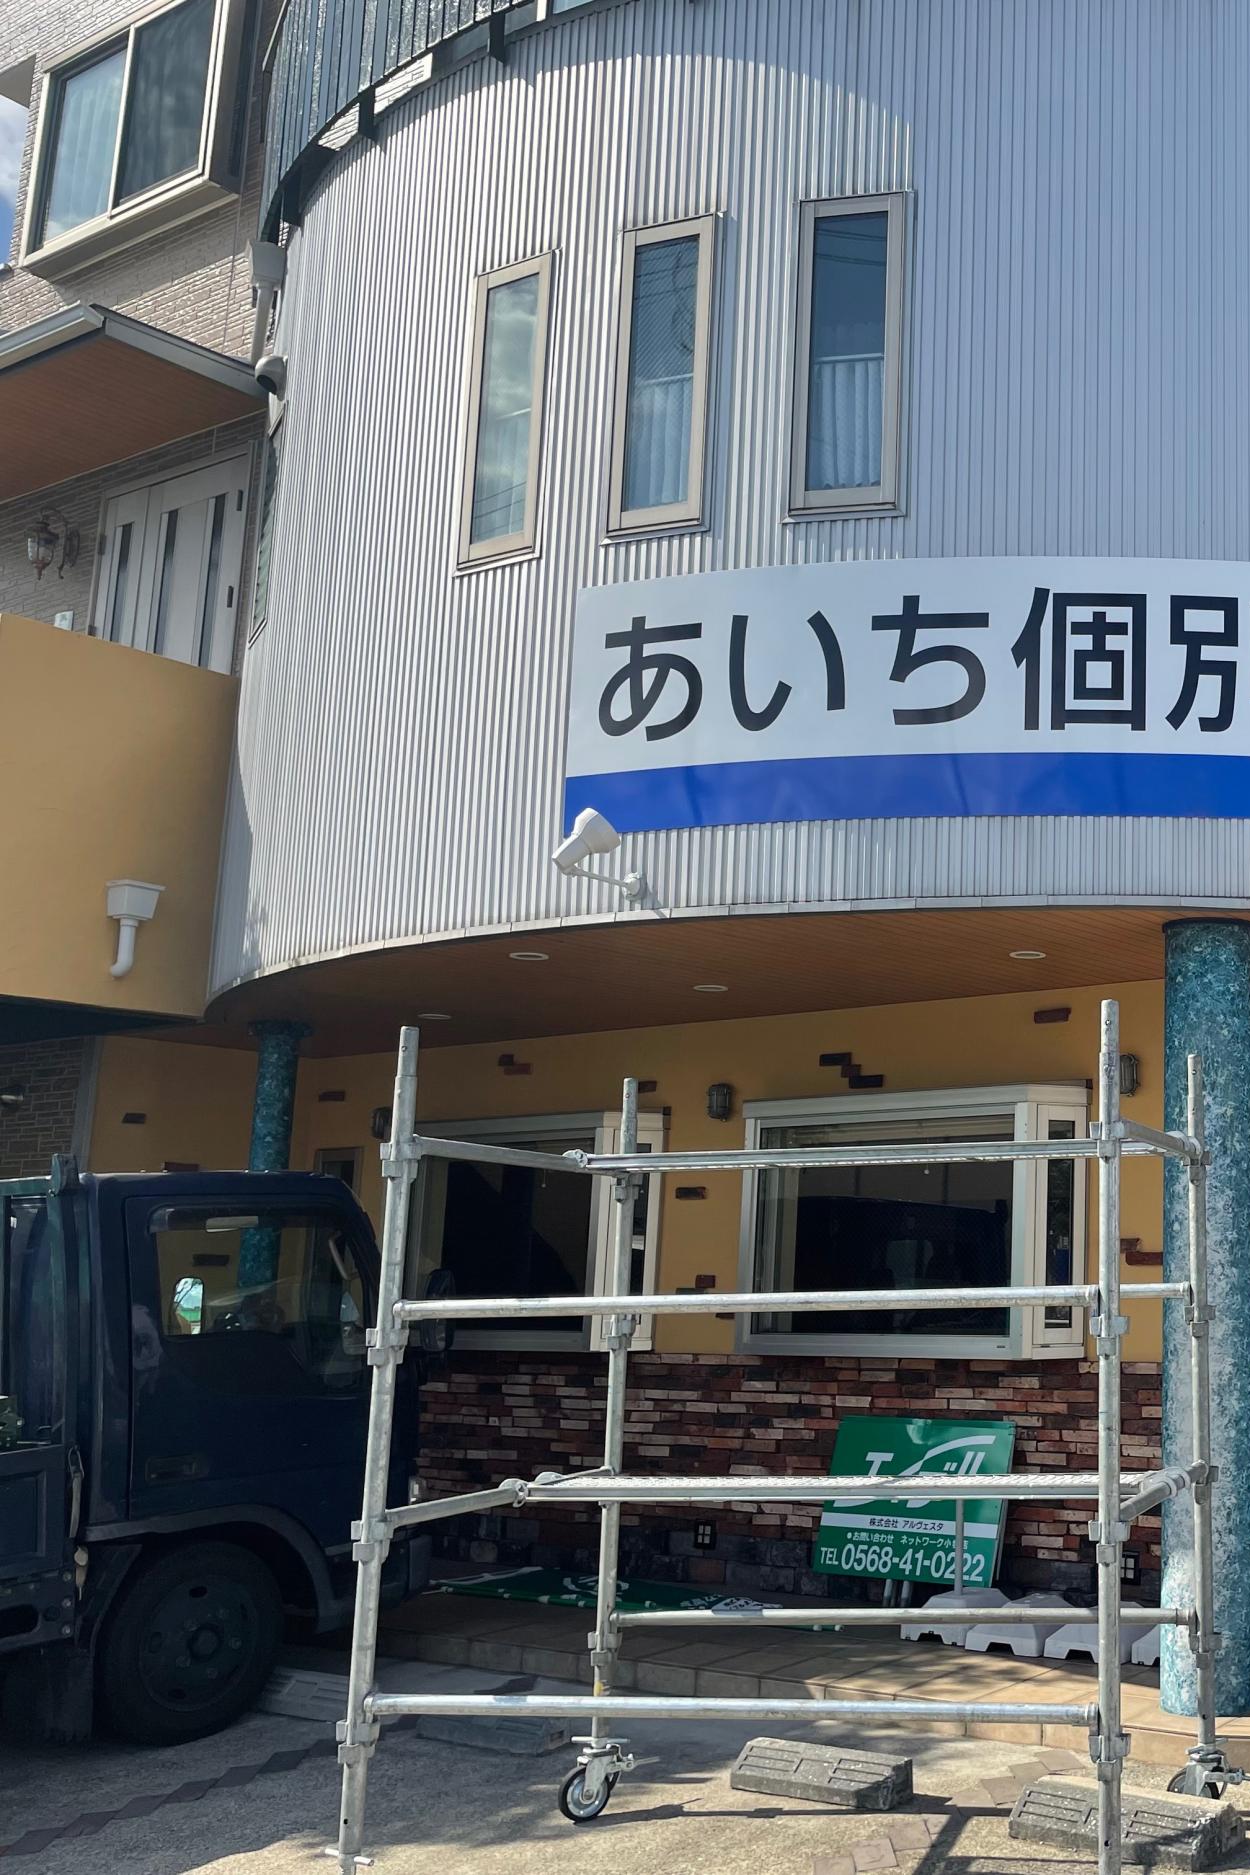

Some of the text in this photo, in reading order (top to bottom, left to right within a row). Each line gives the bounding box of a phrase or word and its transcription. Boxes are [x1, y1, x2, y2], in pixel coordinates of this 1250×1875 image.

[869, 1517, 944, 1532] 株式会社 アルヴェスタ
[820, 1543, 986, 1582] TEL 0568-41-0222
